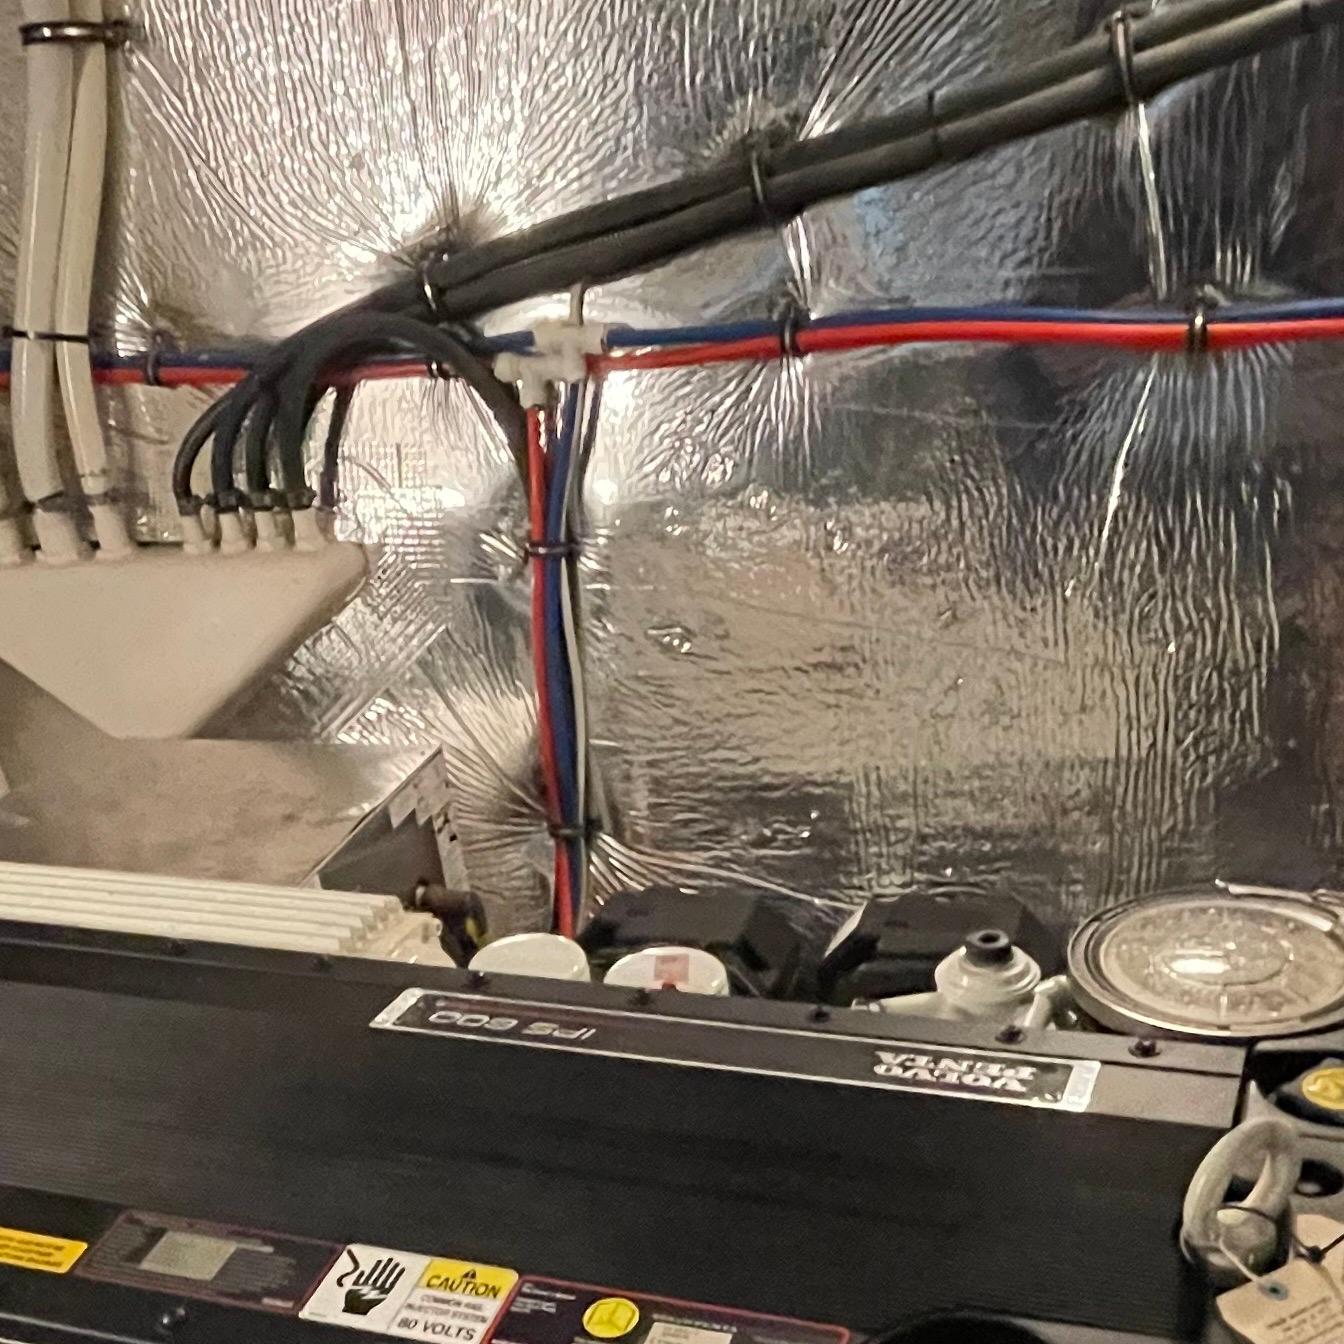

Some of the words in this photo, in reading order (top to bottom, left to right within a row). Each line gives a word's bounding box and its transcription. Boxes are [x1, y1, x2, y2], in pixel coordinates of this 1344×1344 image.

[429, 1010, 519, 1030] 600
[522, 1021, 597, 1040] IPS
[872, 1063, 1029, 1092] VOLVO
[873, 1050, 1038, 1081] PENTA
[426, 1274, 501, 1299] CAUTION
[398, 1317, 417, 1330] 80
[423, 1320, 476, 1341] VOLTS
